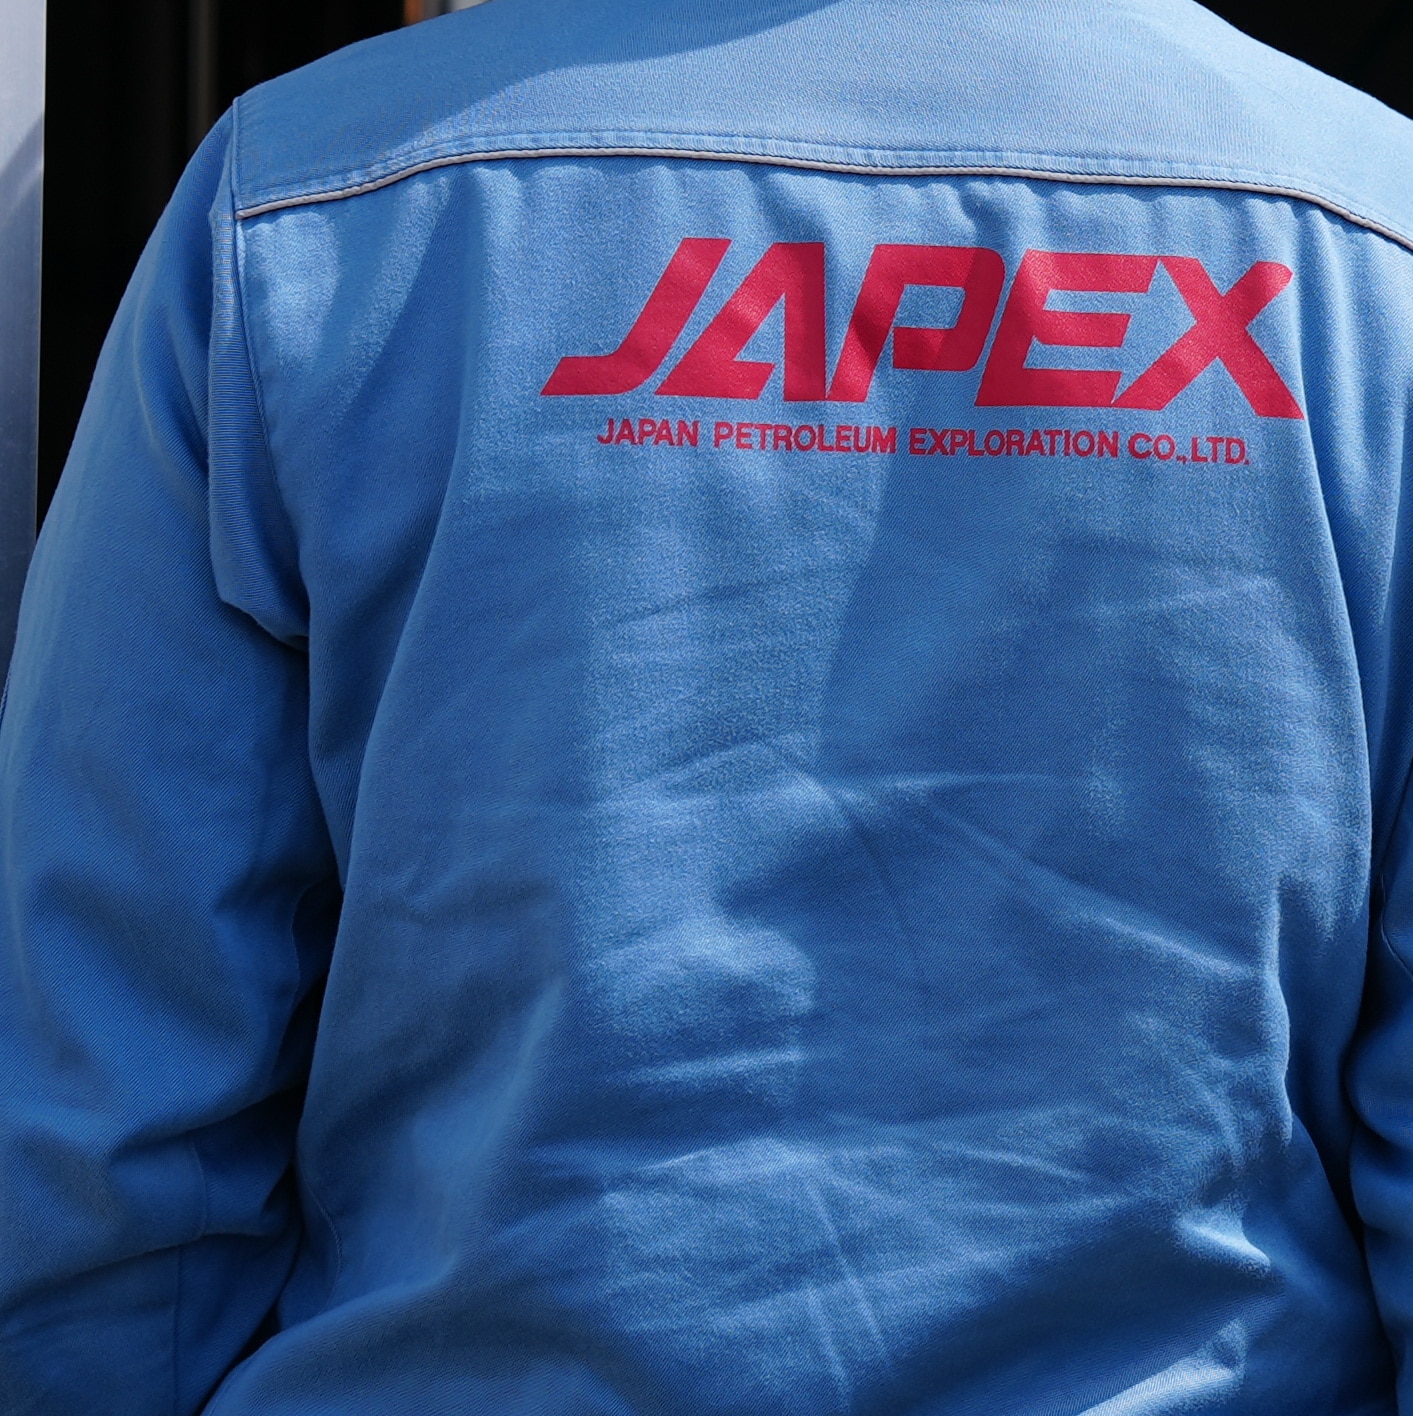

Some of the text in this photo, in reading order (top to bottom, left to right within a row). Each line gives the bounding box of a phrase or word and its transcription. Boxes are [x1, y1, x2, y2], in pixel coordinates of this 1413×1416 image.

[540, 237, 1305, 420] JAPEX
[597, 418, 699, 447] JAPAN
[713, 421, 898, 454] PETROLEUM
[908, 427, 1119, 459] EXPLORATION
